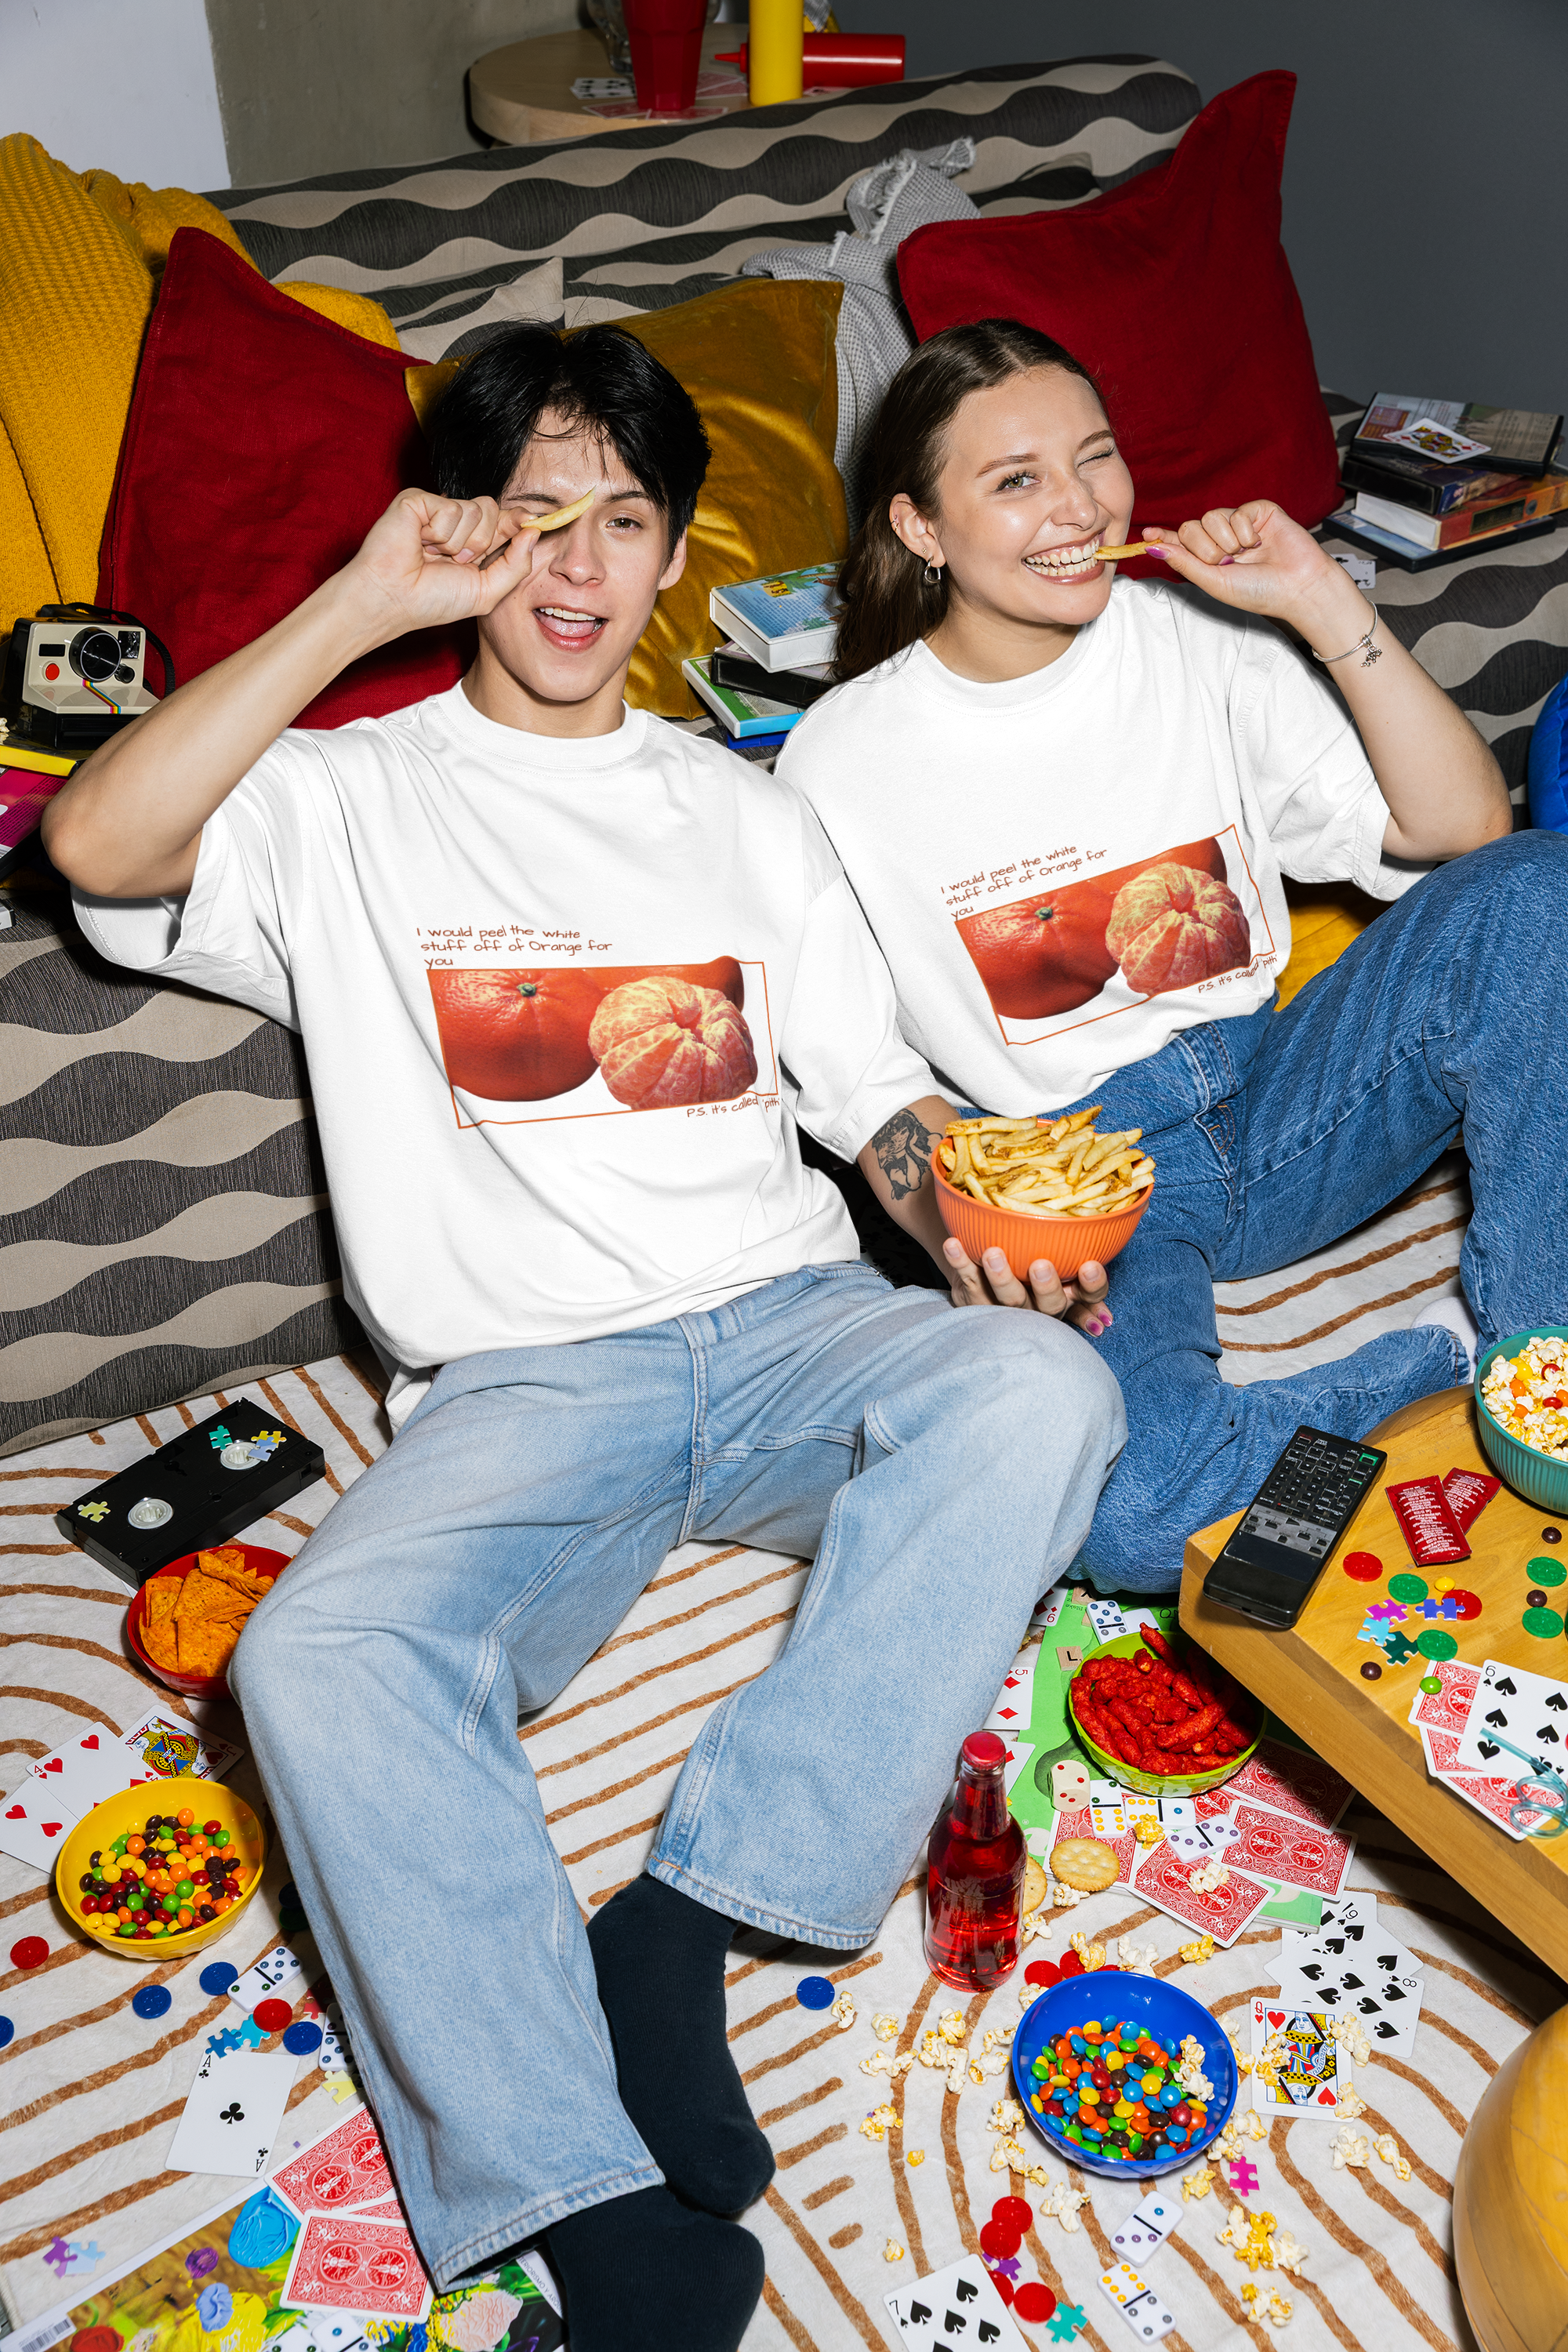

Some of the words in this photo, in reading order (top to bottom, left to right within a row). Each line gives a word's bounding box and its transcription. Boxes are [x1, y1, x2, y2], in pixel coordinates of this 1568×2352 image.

[949, 870, 985, 891] would
[989, 862, 1017, 883] peel
[1021, 857, 1042, 869] the
[1045, 846, 1077, 861] white
[946, 886, 982, 906] stuff
[988, 877, 1013, 893] off
[1018, 869, 1035, 884] of
[1040, 858, 1083, 876] Orange
[1086, 849, 1107, 861] for
[950, 906, 974, 922] you
[416, 927, 421, 936] I
[427, 925, 473, 937] would
[479, 924, 507, 942] peel
[510, 924, 535, 935] the
[543, 930, 581, 938] white
[420, 938, 467, 951] stuff
[474, 939, 502, 951] off
[508, 938, 524, 951] of
[528, 941, 583, 956] Orange
[587, 939, 612, 951] for
[423, 958, 453, 971] you
[1218, 975, 1232, 985] it's
[1236, 957, 1259, 979] called
[711, 1105, 728, 1114] it's
[731, 1095, 759, 1112] called
[1066, 1651, 1079, 1662] L
[1485, 1664, 1497, 1678] 6
[34, 1764, 44, 1774] 4
[1402, 1977, 1417, 1988] 8
[1254, 2001, 1264, 2014] Q
[201, 2055, 212, 2068] A
[255, 2158, 265, 2172] A
[888, 2299, 899, 2315] 7
